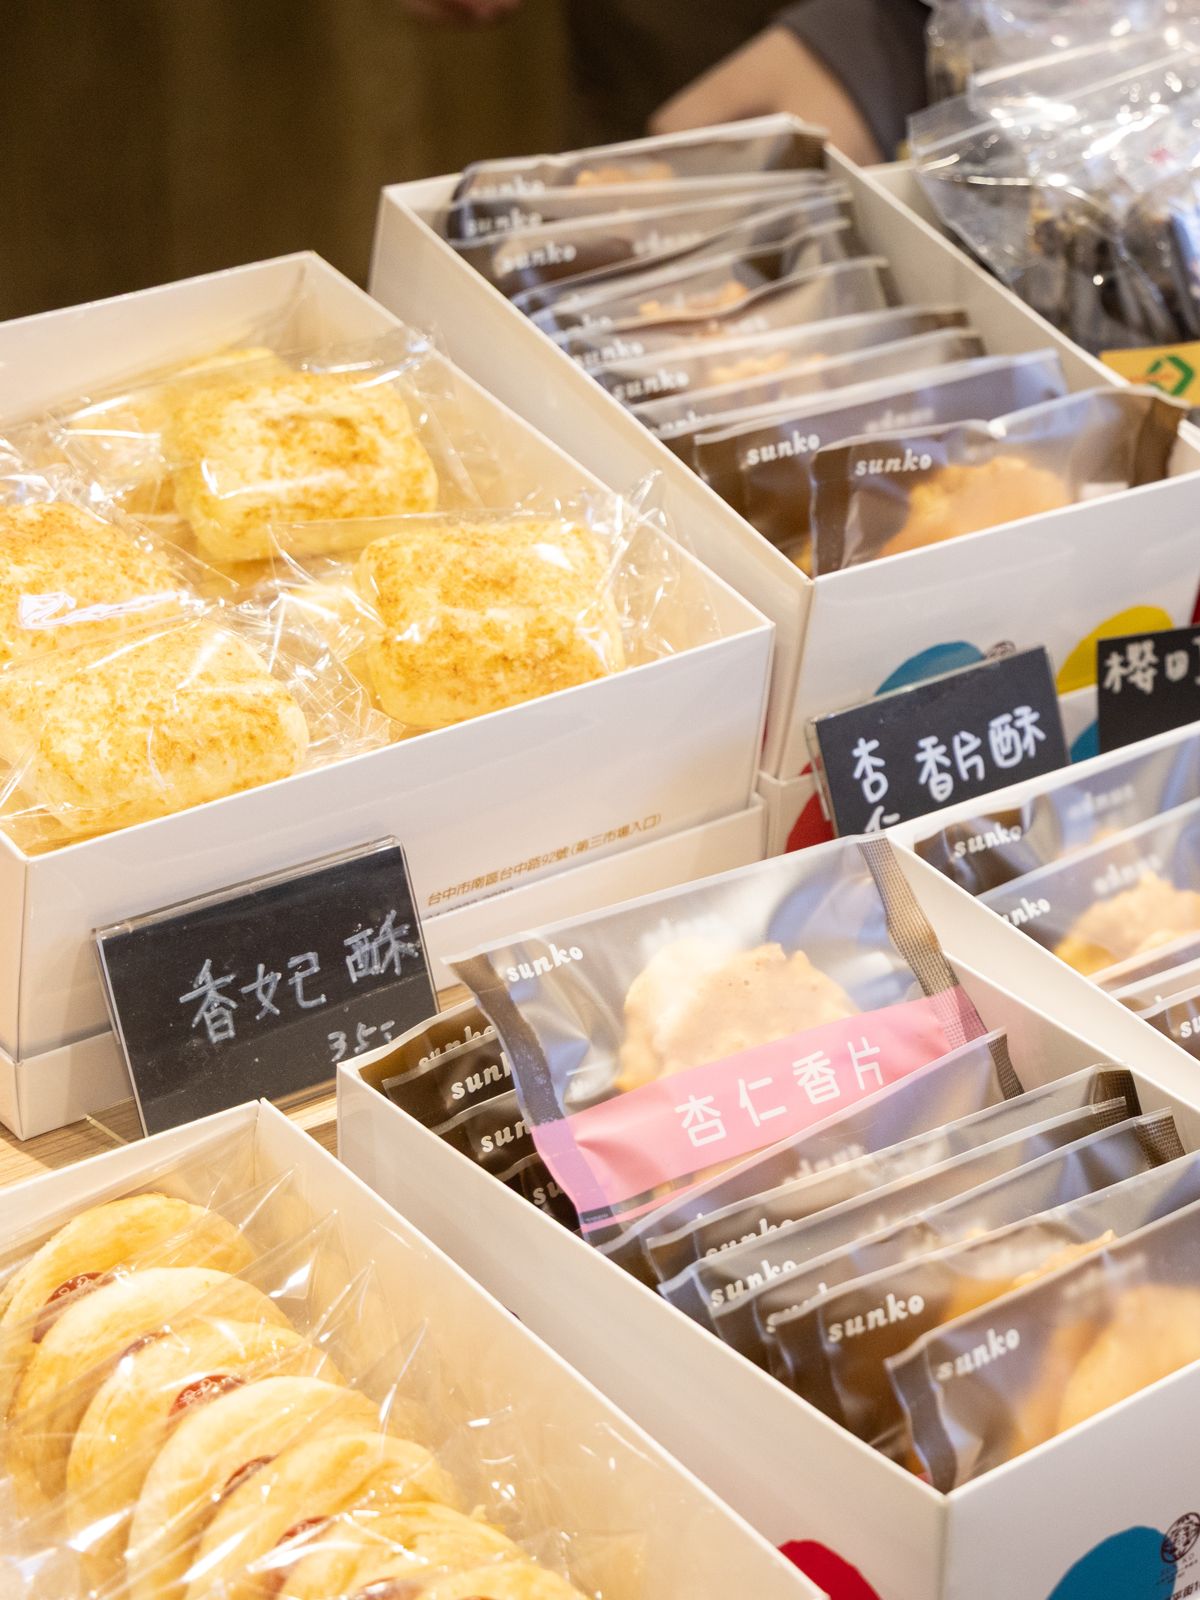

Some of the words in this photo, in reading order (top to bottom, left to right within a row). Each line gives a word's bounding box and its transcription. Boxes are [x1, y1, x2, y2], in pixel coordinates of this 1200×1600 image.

[746, 430, 820, 466] sunko
[855, 447, 932, 477] sunko
[953, 823, 1022, 859] sunko
[1000, 898, 1051, 928] unko
[505, 943, 584, 983] sunko
[451, 1052, 513, 1100] sunk
[674, 1036, 885, 1148] 杏仁香片
[481, 1119, 531, 1153] sun
[710, 1259, 797, 1309] sunko
[828, 1293, 925, 1343] sunko
[937, 1328, 1021, 1381] sunko
